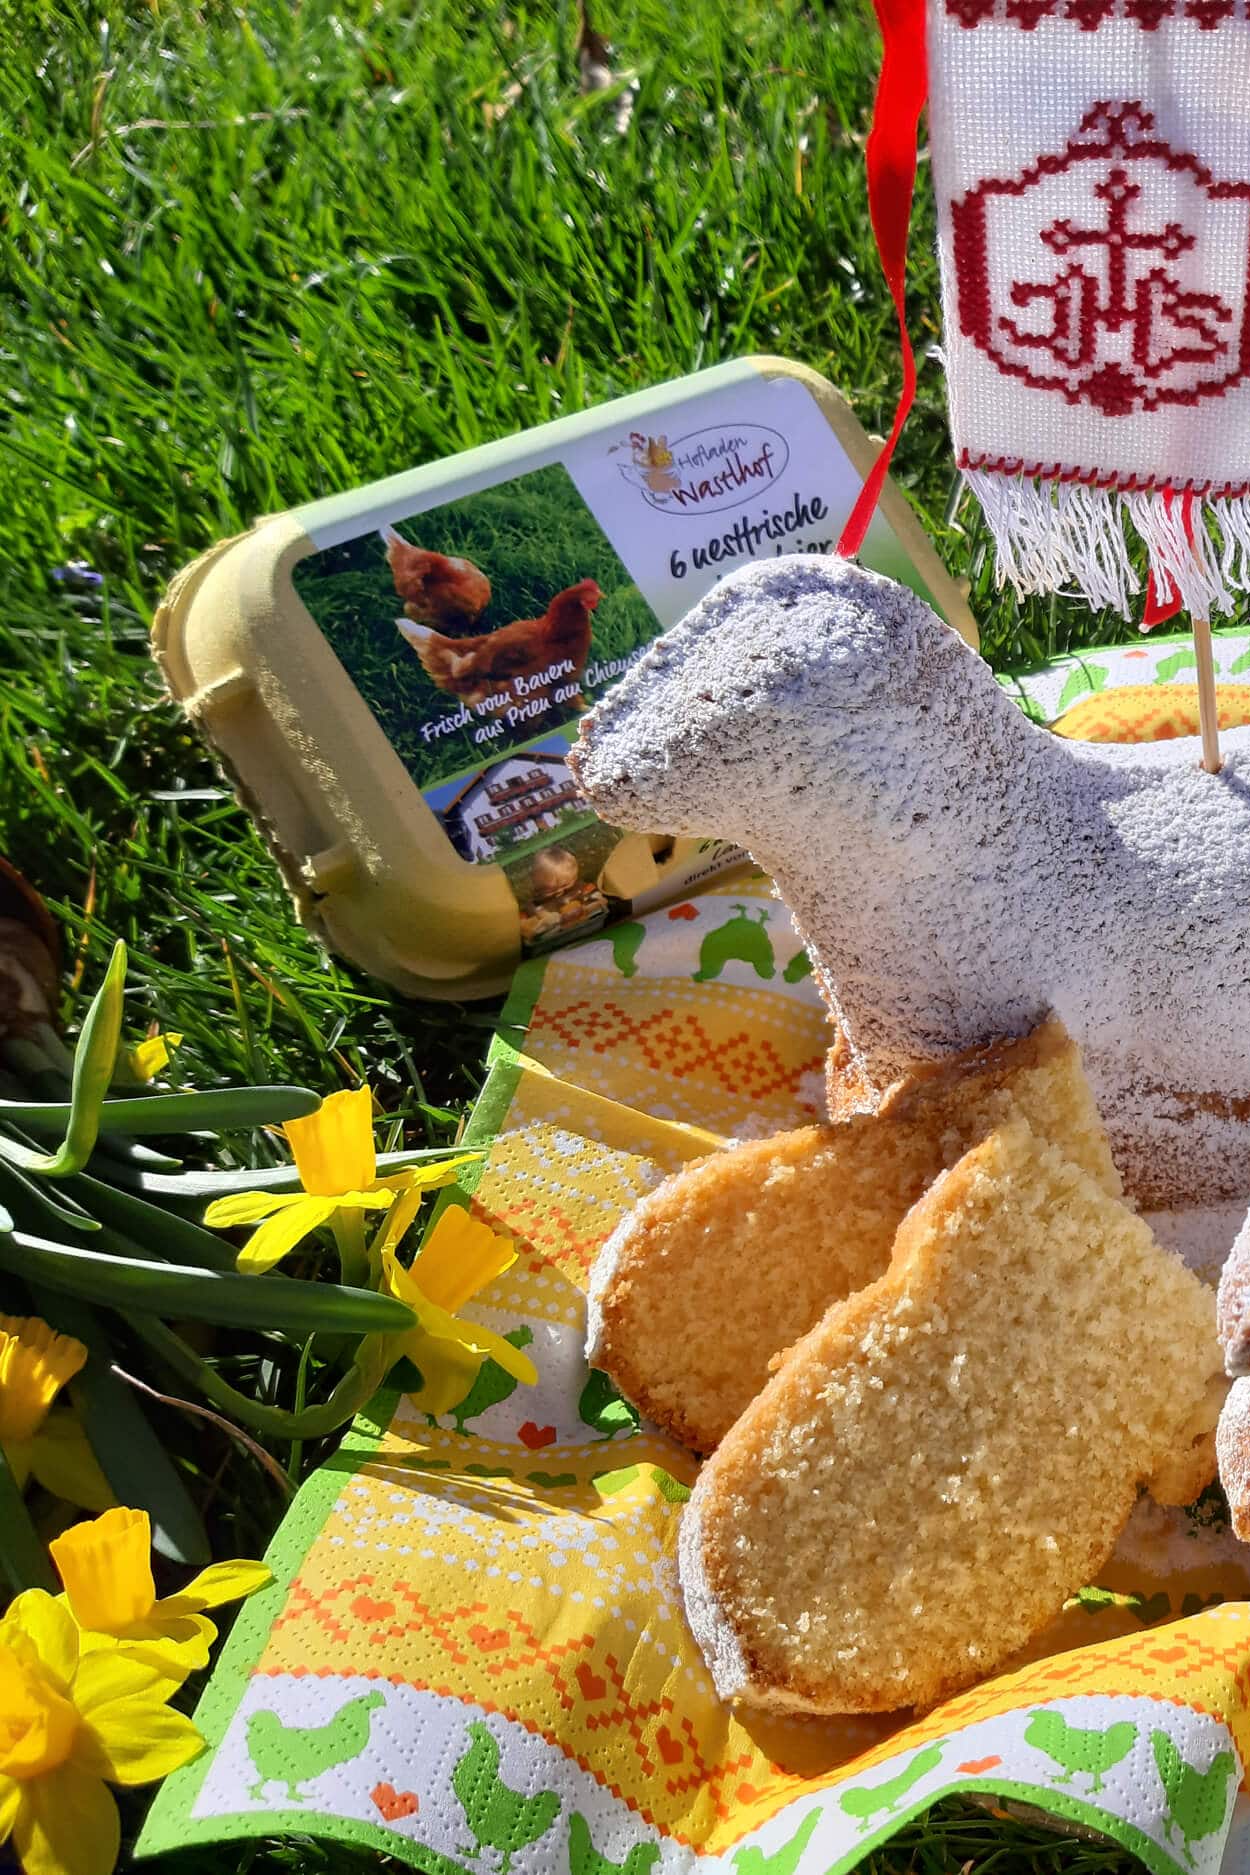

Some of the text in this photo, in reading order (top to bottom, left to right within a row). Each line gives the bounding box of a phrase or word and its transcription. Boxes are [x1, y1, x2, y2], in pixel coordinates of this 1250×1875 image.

[677, 436, 748, 470] Hofladen
[672, 442, 774, 506] Wastlhof
[670, 550, 687, 578] 6
[420, 702, 474, 742] Frisch
[474, 719, 505, 744] aus
